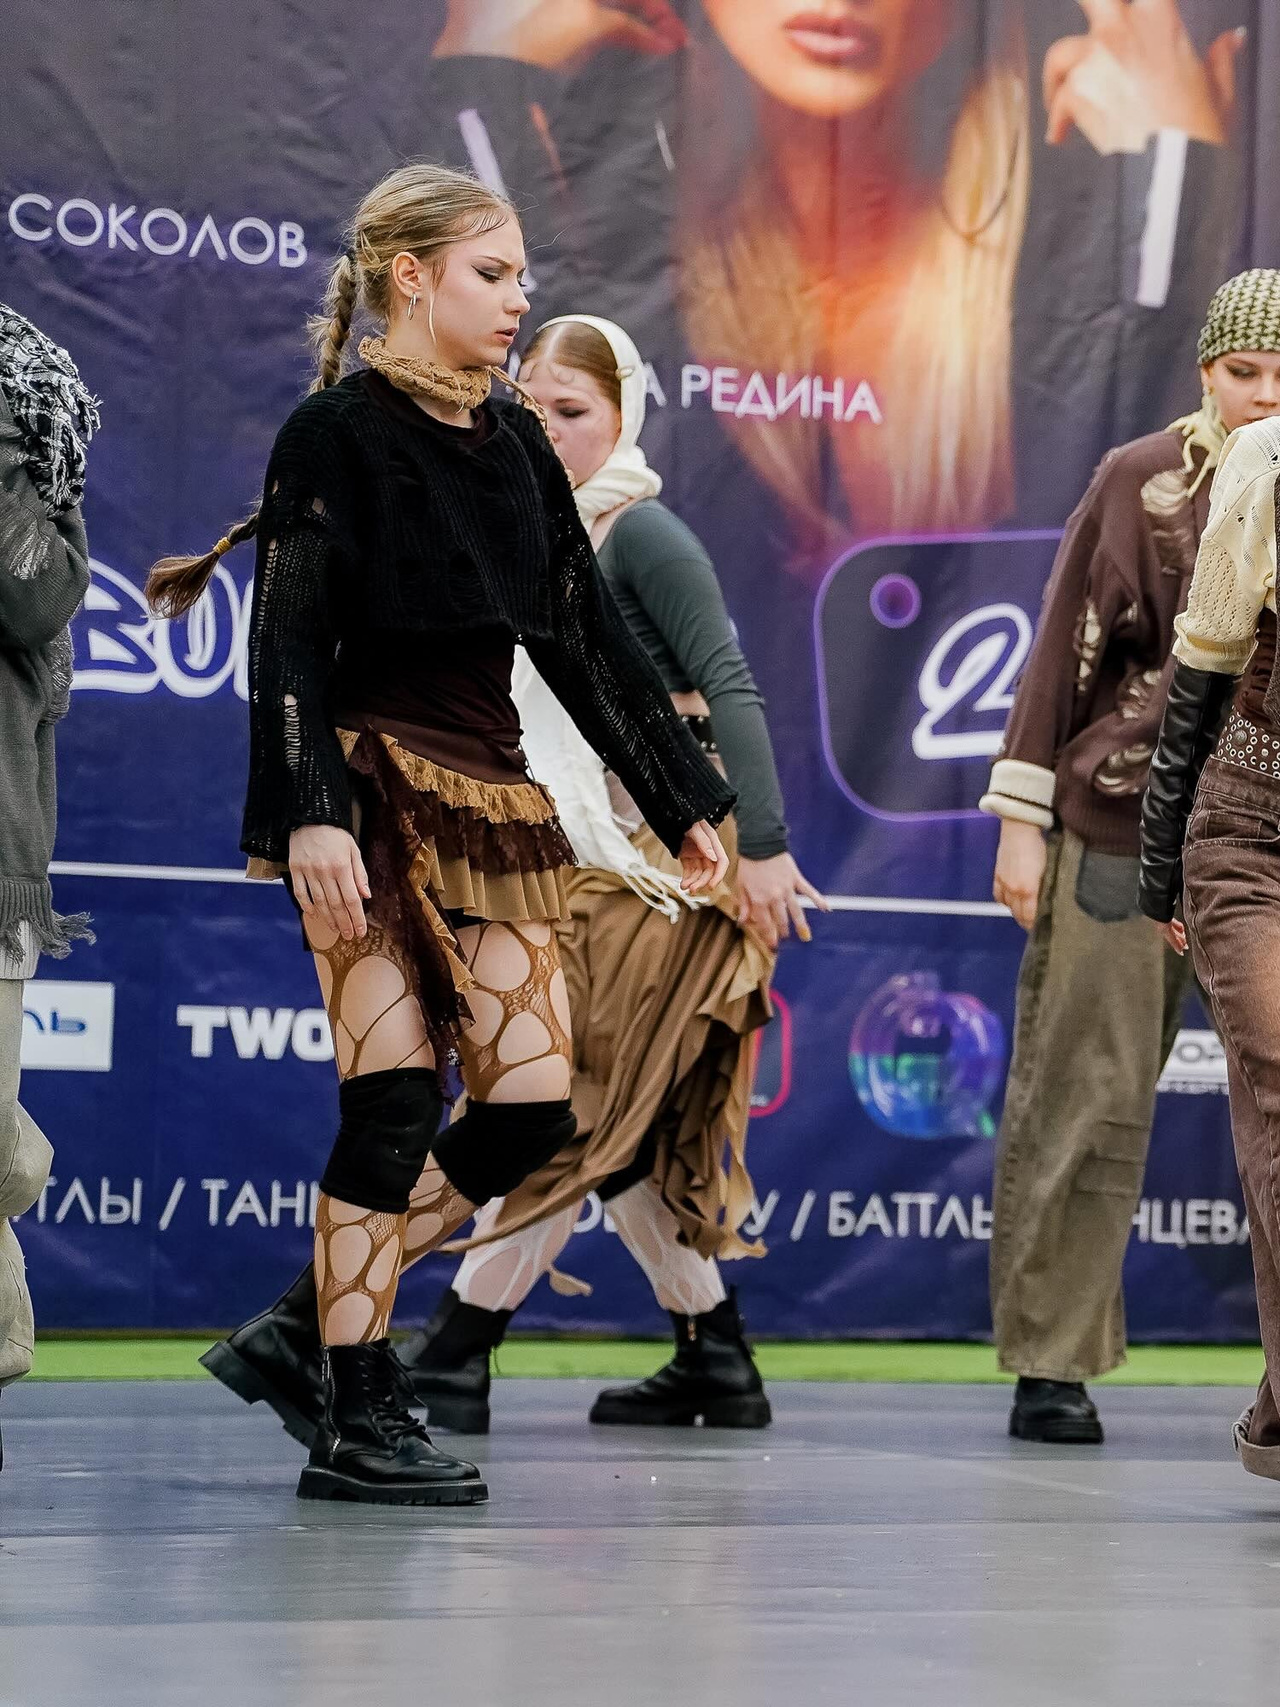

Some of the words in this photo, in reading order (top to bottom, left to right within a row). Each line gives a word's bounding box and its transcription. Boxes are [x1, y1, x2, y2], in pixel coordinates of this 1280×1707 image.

[8, 193, 308, 268] СОКОЛОВ
[681, 363, 883, 424] РЕДИНА
[37, 1176, 142, 1225] ТЛЫ
